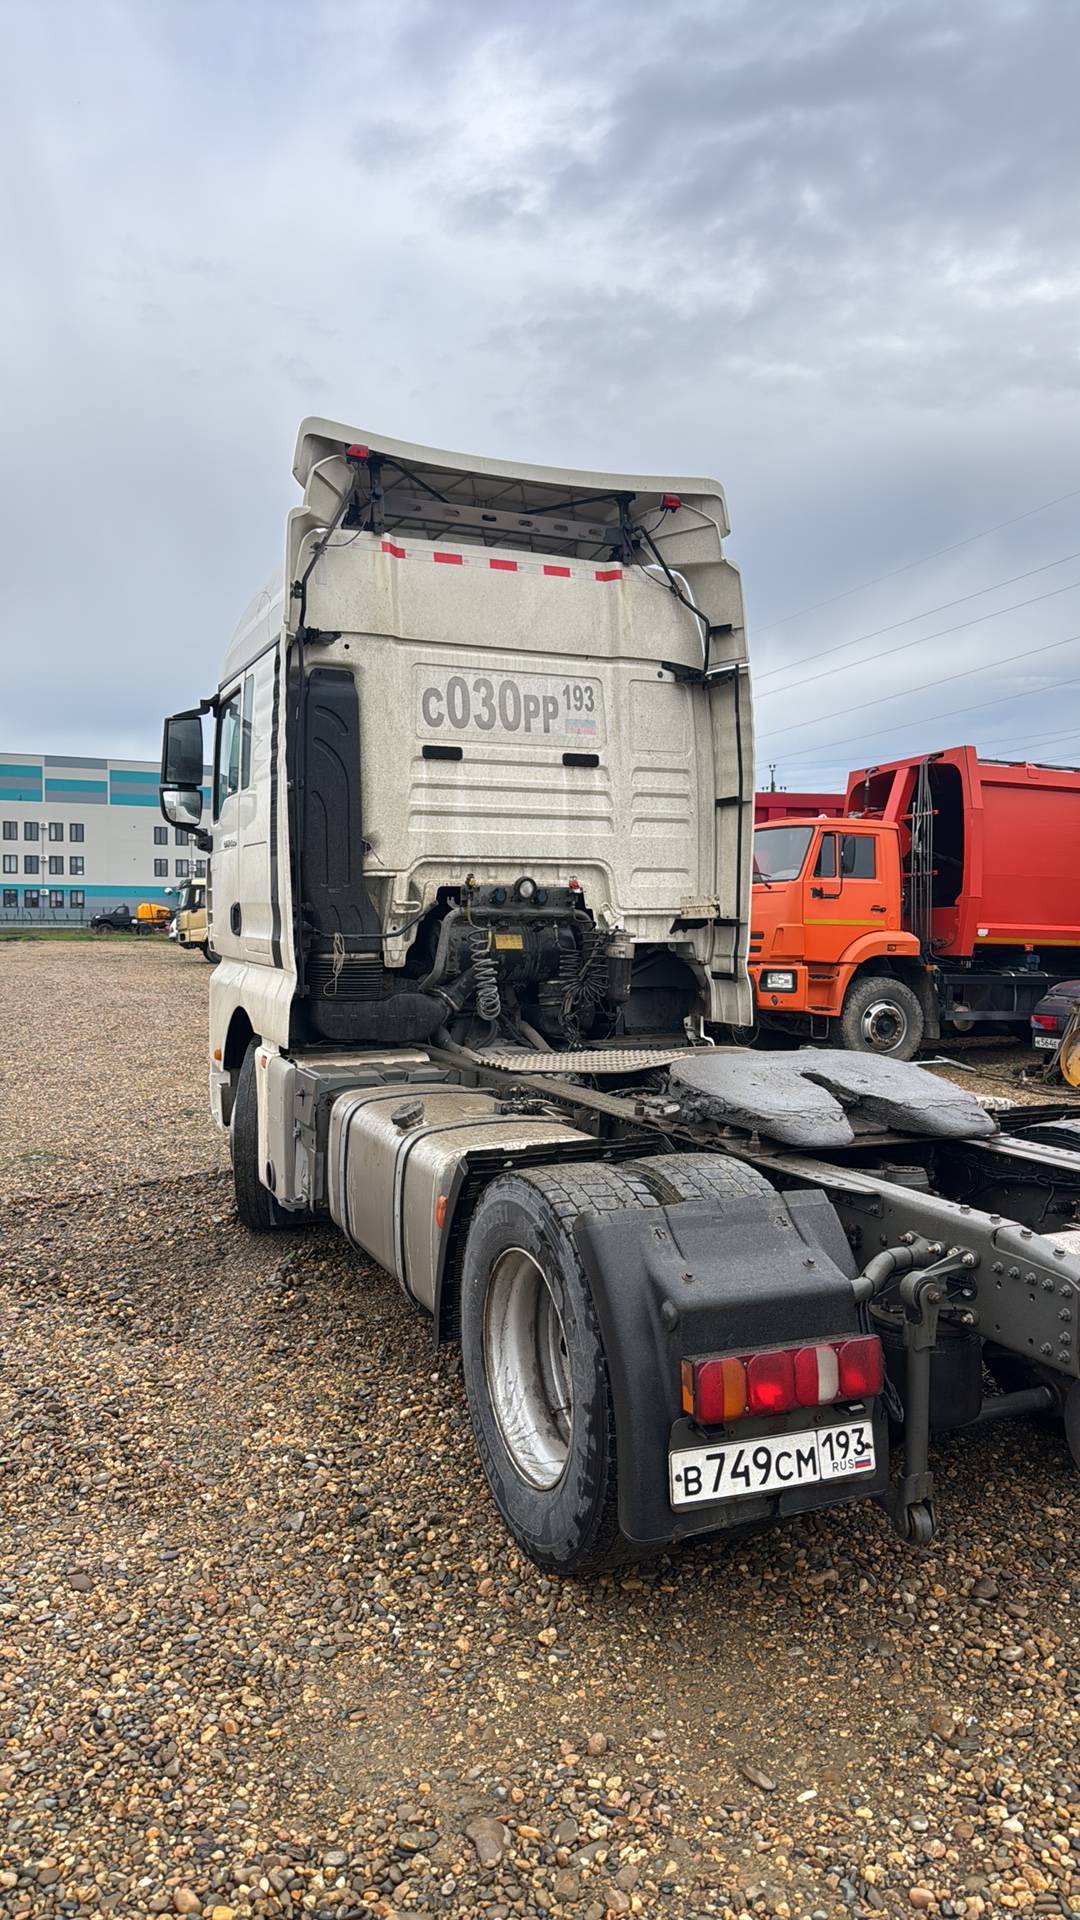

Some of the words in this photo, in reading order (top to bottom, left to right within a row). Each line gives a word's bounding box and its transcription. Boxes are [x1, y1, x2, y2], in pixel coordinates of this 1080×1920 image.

[562, 684, 595, 713] 193
[821, 1427, 866, 1461] 193
[832, 1458, 855, 1472] RUS
